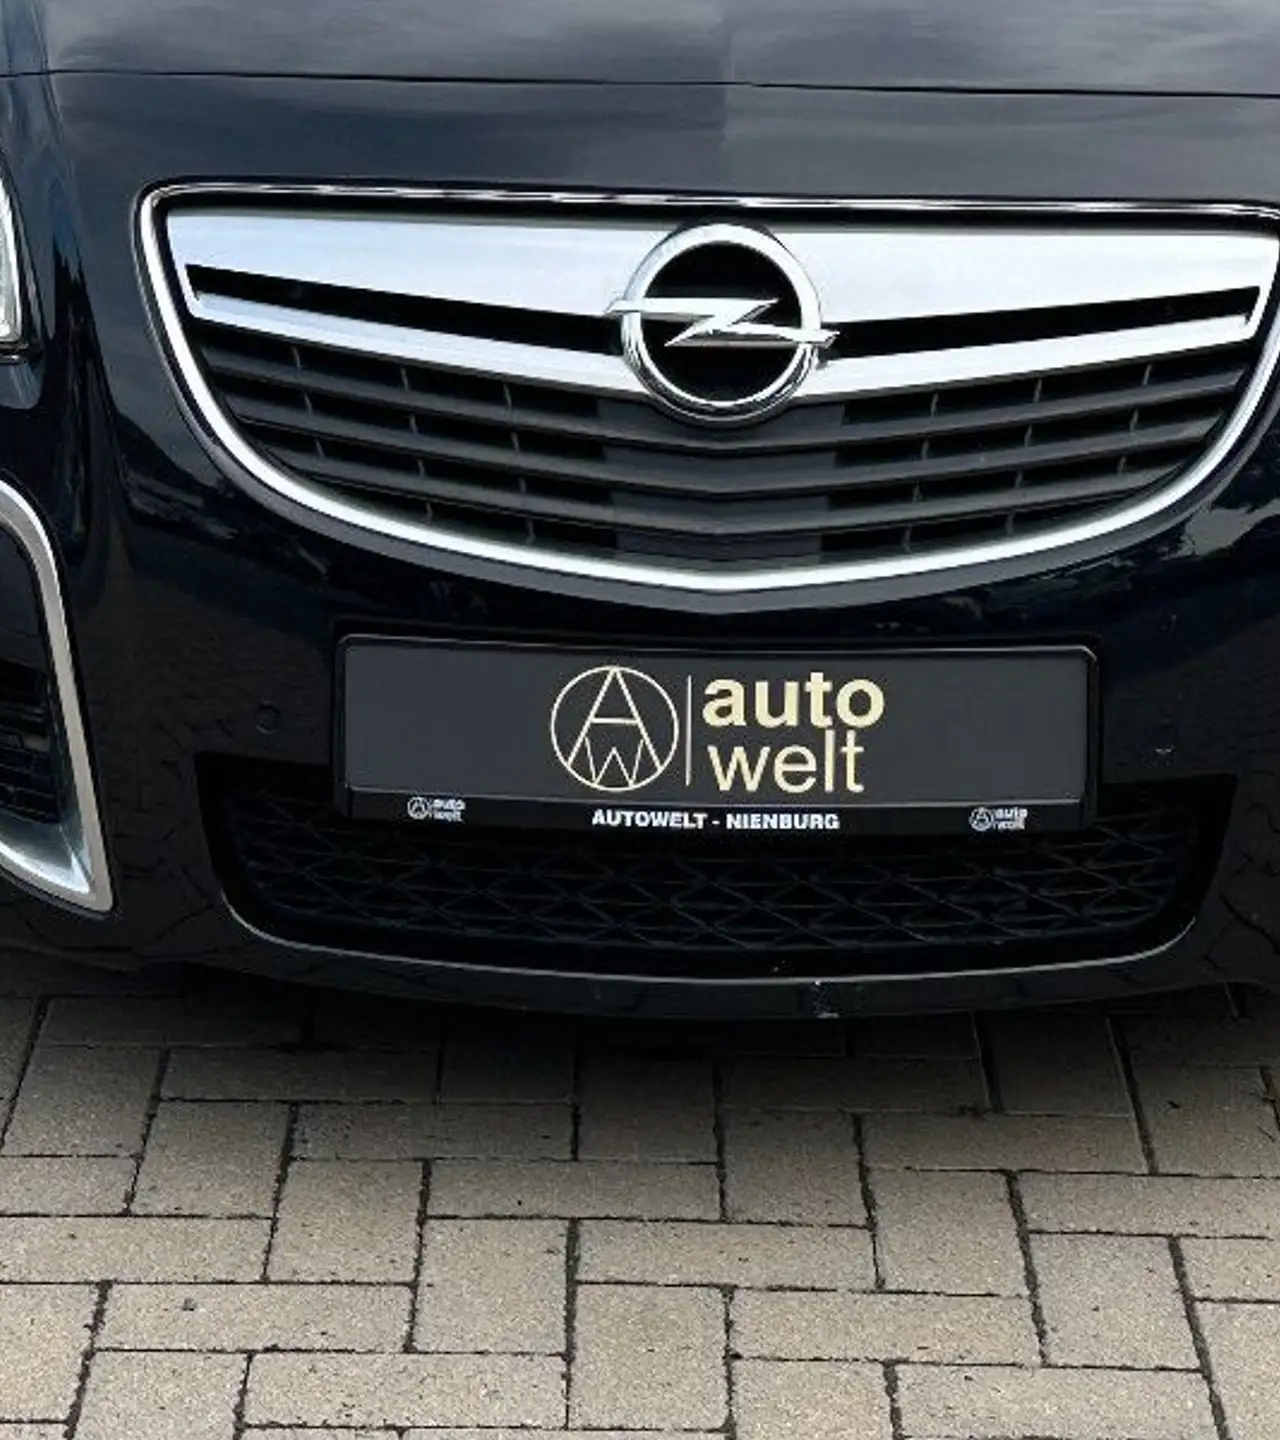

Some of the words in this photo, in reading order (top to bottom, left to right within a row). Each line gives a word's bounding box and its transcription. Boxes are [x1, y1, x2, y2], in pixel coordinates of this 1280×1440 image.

[702, 672, 885, 728] auto
[708, 729, 865, 793] welt
[591, 808, 708, 830] AUTOWELT
[726, 812, 840, 830] NIENBURG
